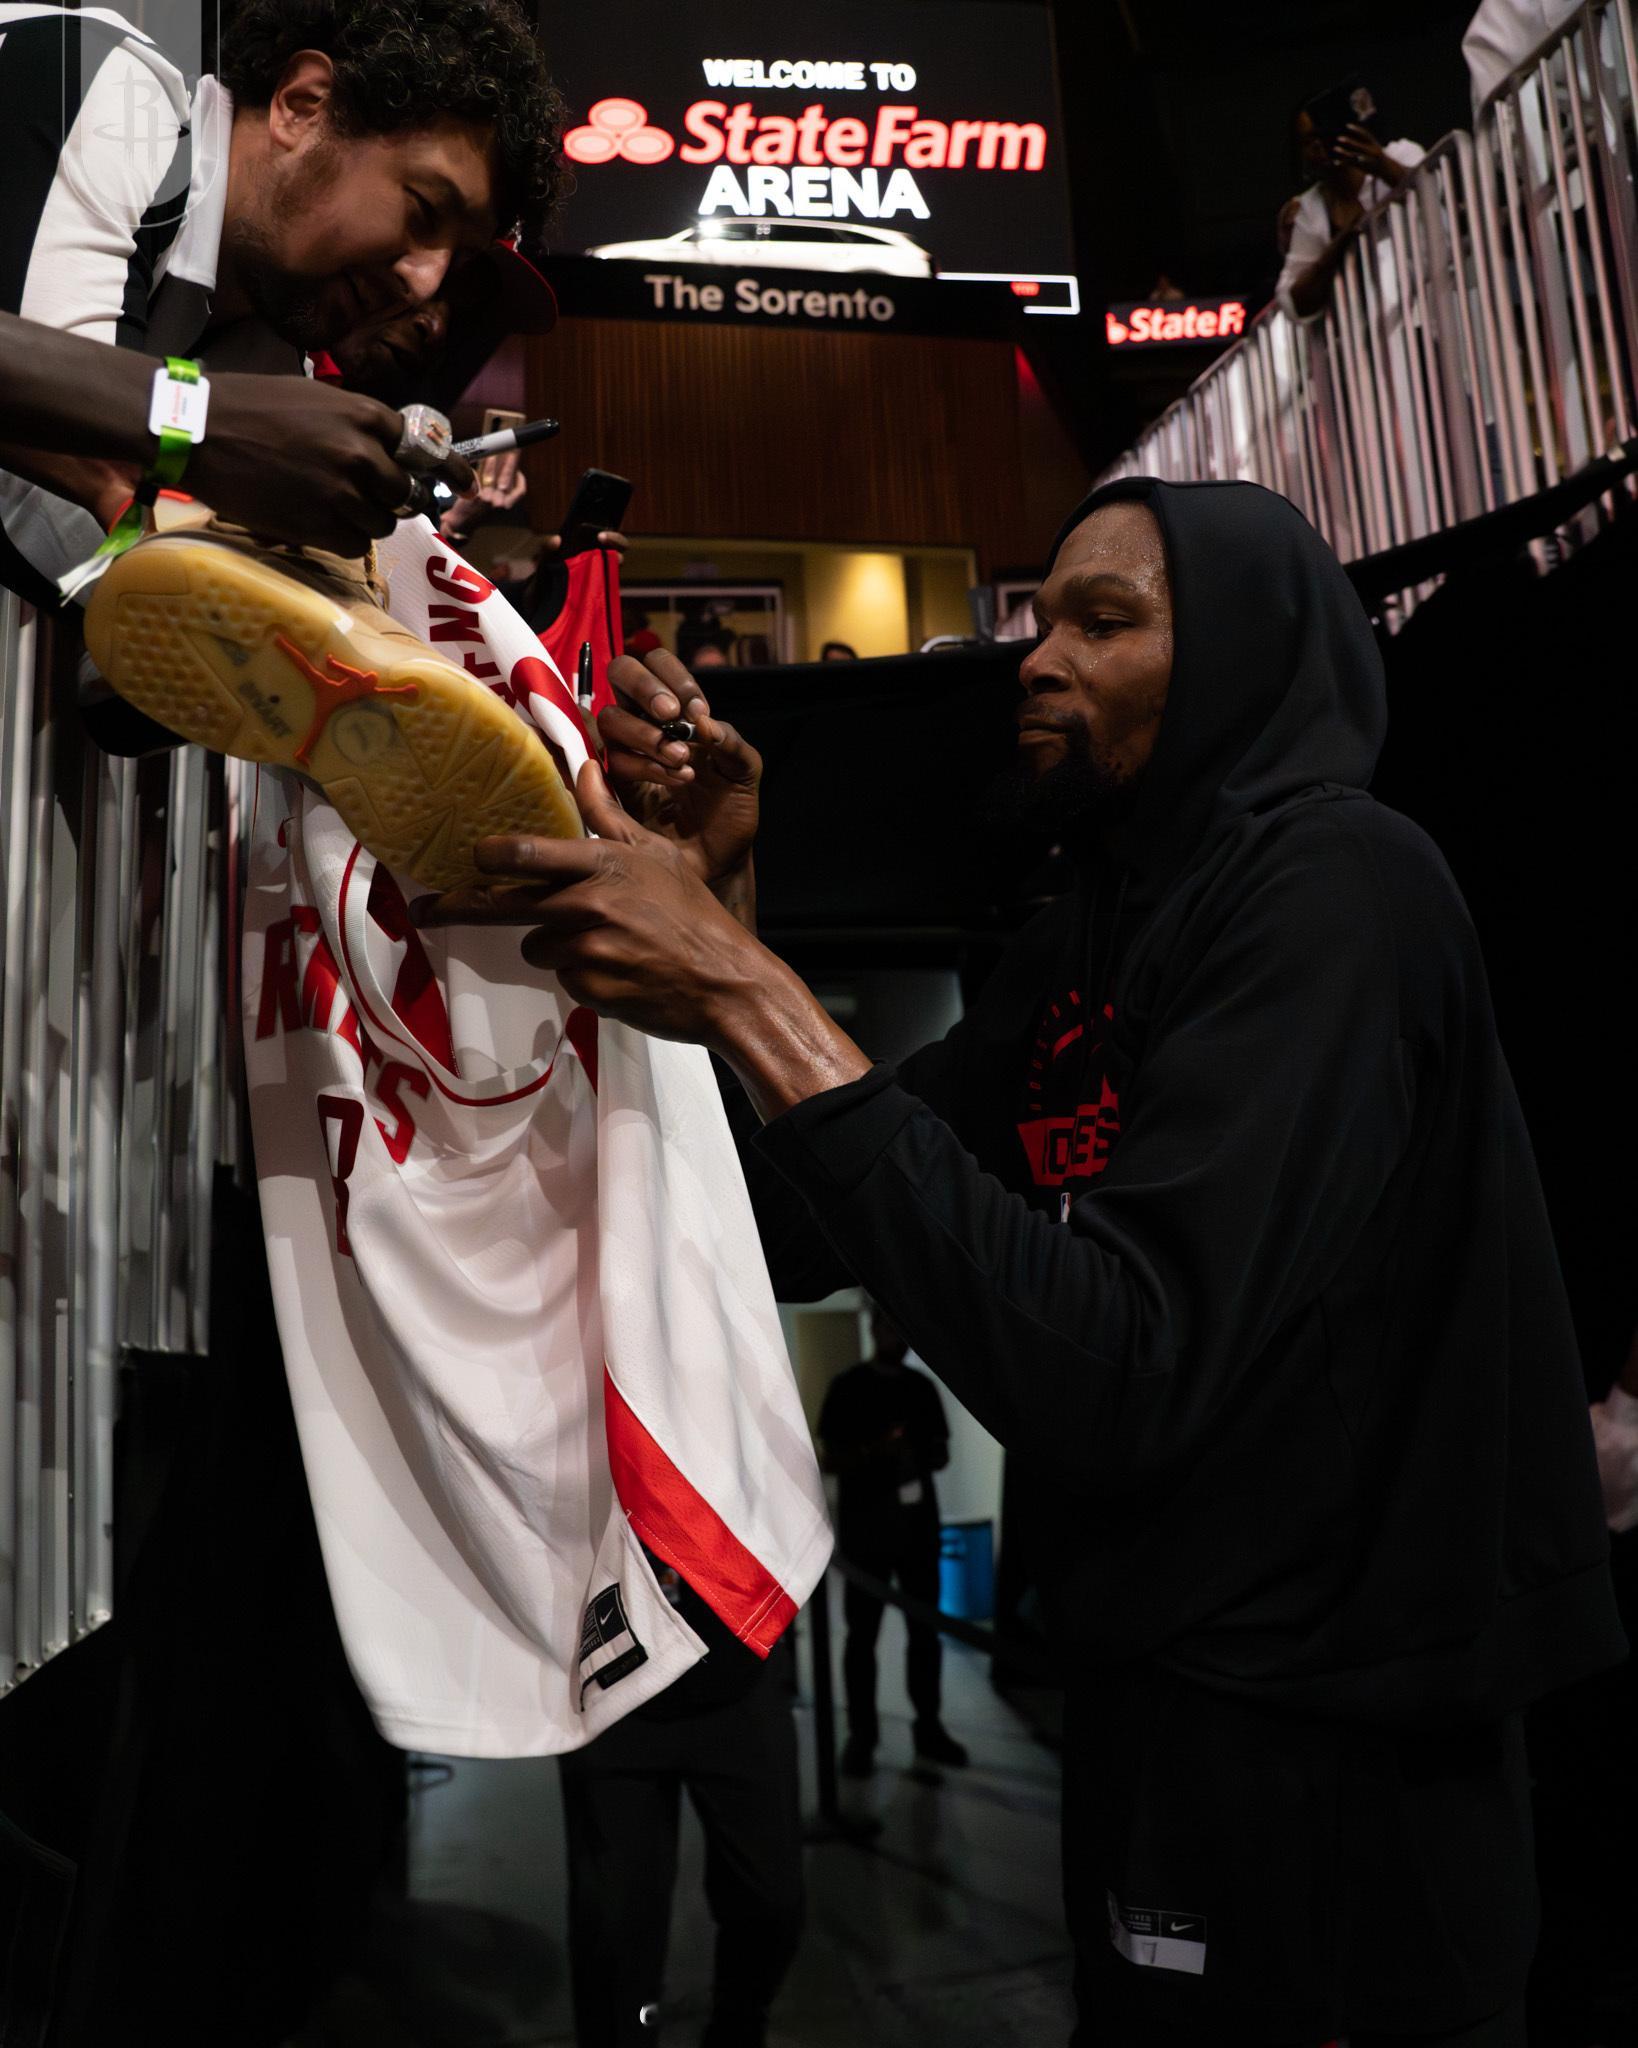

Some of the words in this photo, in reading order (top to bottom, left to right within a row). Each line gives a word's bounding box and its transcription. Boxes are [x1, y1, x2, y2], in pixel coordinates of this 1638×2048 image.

[702, 58, 867, 91] WELCOME
[870, 63, 917, 92] TO
[698, 165, 931, 219] ARENA
[645, 275, 723, 311] The
[735, 277, 894, 322] Sorento
